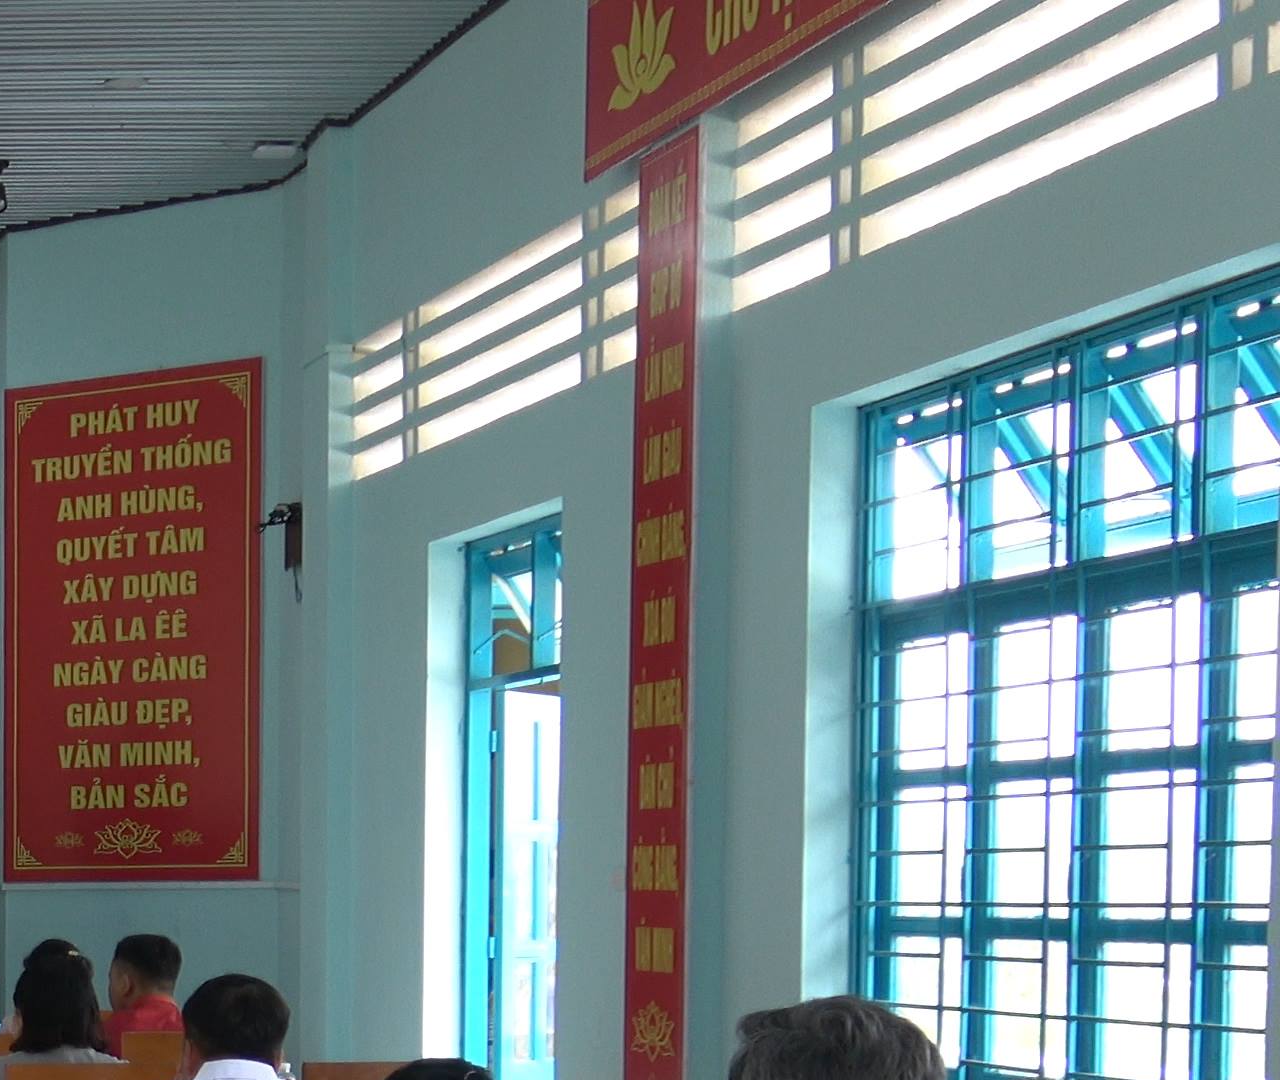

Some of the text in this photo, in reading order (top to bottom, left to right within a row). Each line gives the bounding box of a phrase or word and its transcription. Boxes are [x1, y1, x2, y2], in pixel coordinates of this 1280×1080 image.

[70, 399, 200, 438] PHÁT HUY
[31, 433, 231, 483] TRUYỀN THỐNG
[57, 484, 203, 522] ANH HÙNG,
[56, 524, 204, 565] QUYẾT TÂM
[63, 570, 197, 604] XÂY DỰNG
[71, 608, 187, 645] XÃ LA ÊÊ
[53, 652, 207, 687] NGÀY CÀNG
[66, 697, 192, 729] GIÀU ĐẸP,
[58, 739, 201, 769] VĂN MINH,
[70, 774, 188, 810] BẢN SẮC
